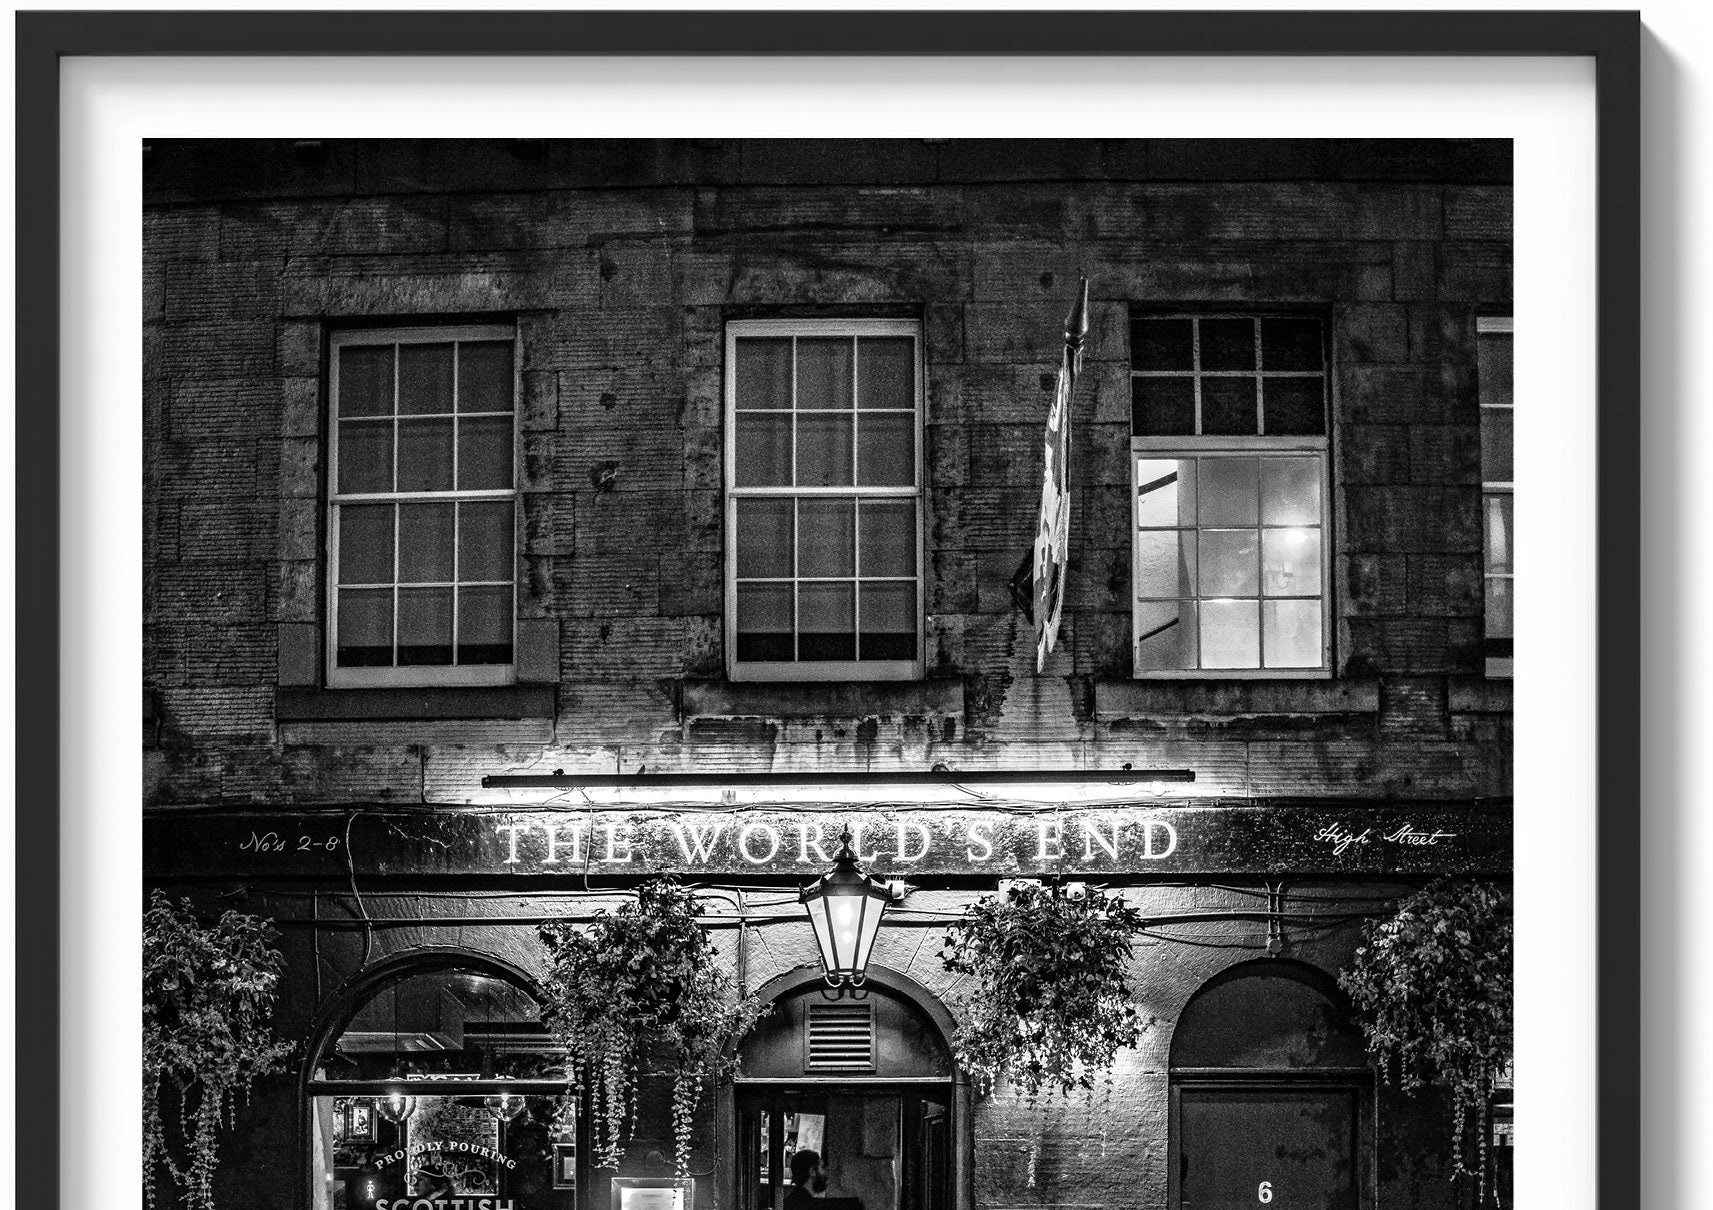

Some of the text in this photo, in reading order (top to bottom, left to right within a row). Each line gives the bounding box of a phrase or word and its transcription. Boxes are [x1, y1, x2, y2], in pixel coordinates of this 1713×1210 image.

[297, 835, 339, 851] 2-8
[496, 820, 1178, 865] THE WORLD'S END
[1313, 822, 1457, 856] High Street
[450, 1141, 517, 1170] POURING
[1258, 1181, 1273, 1203] 6
